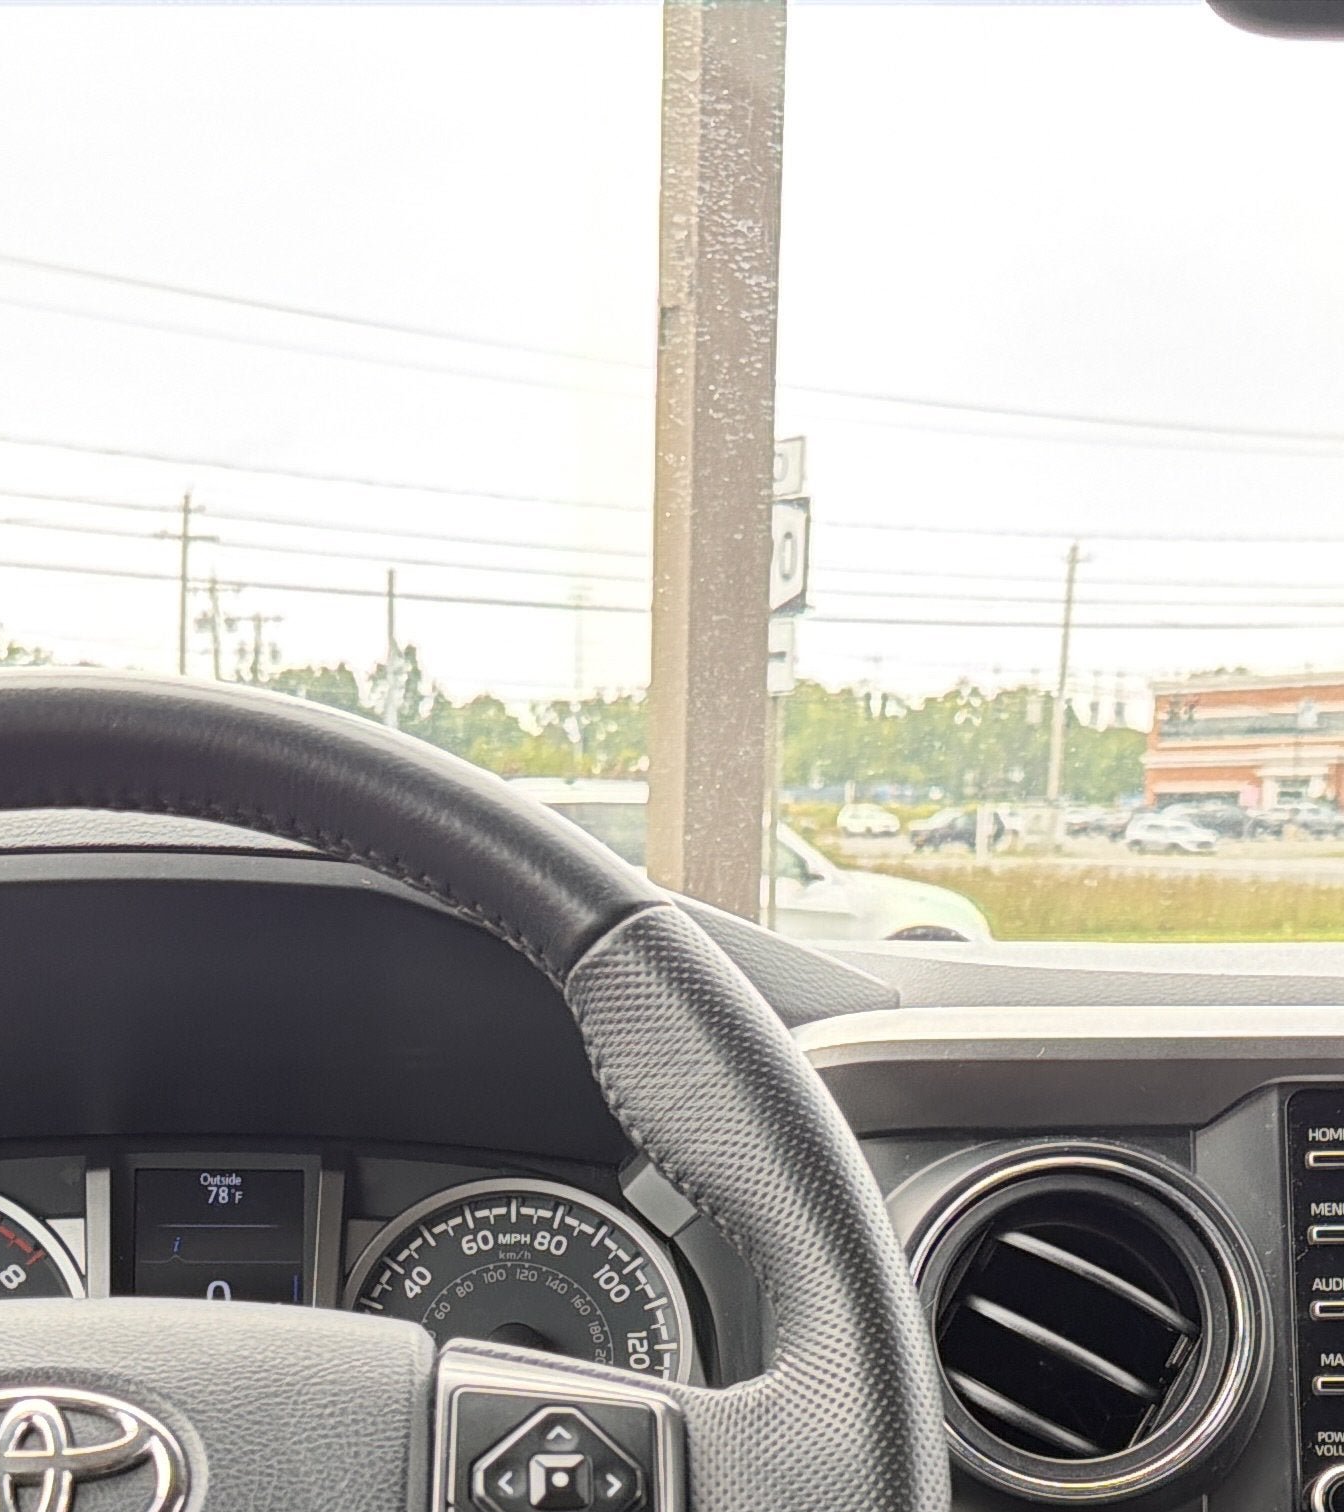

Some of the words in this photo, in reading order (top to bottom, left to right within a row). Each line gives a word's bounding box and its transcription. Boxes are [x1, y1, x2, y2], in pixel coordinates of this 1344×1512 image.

[200, 1173, 242, 1186] Outside
[461, 1230, 494, 1255] 60
[498, 1233, 531, 1245] MPH
[533, 1232, 568, 1256] 80
[499, 1250, 532, 1261] km/h
[404, 1266, 432, 1299] 40
[482, 1269, 506, 1284] 100
[516, 1268, 538, 1282] 120
[593, 1264, 630, 1303] 100
[455, 1280, 474, 1298] 80
[545, 1276, 568, 1295] 140
[434, 1301, 451, 1320] 60
[570, 1294, 591, 1316] 160
[588, 1321, 605, 1344] 180
[626, 1331, 651, 1369] 120
